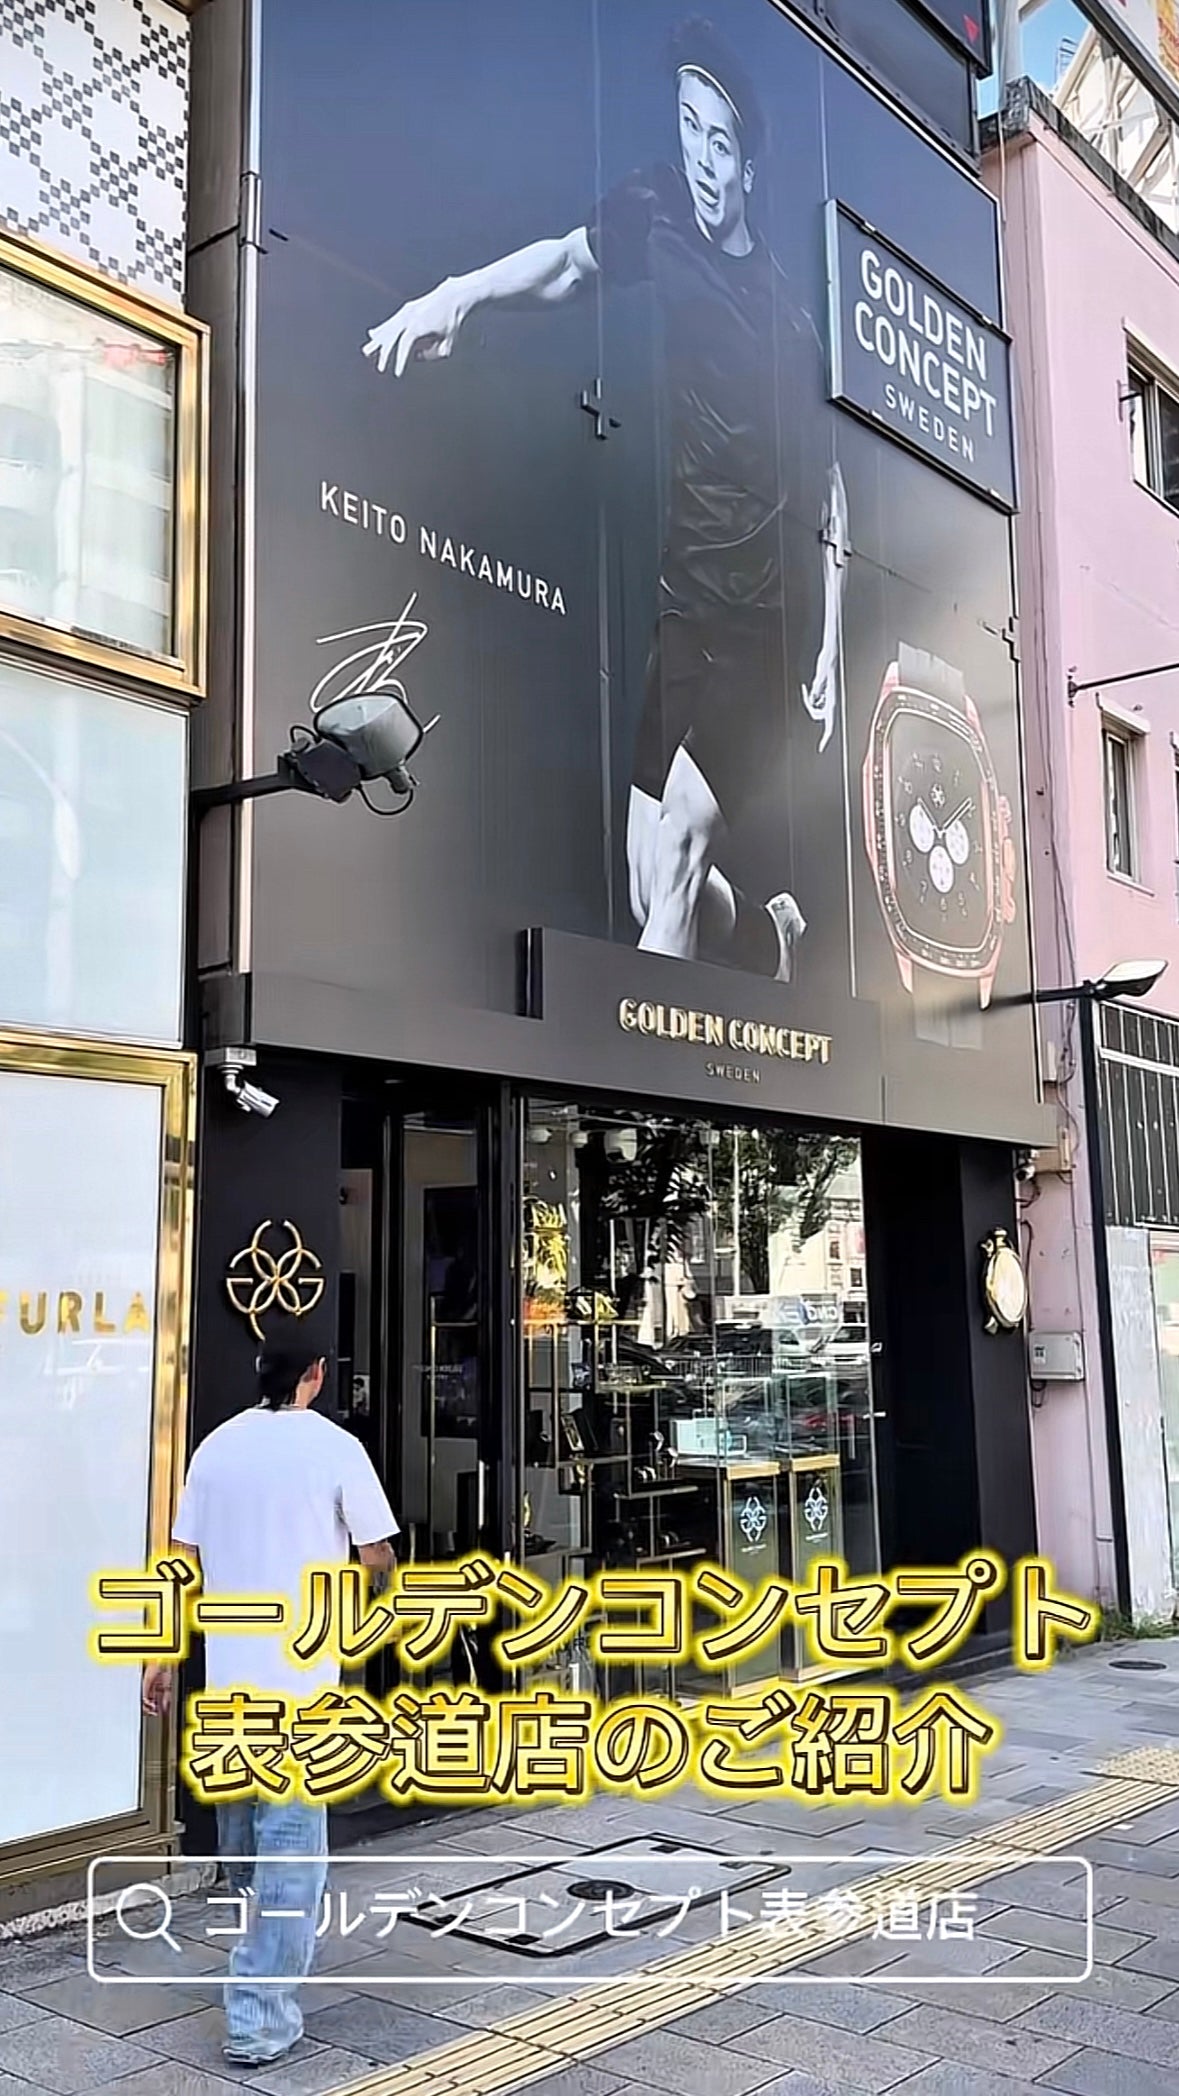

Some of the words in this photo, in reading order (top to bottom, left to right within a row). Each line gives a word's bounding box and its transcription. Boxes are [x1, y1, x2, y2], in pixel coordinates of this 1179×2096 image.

[854, 300, 997, 437] CONCEPT
[860, 249, 987, 382] GOLDEN
[884, 383, 975, 463] SWEDEN
[320, 480, 407, 544] KEITO
[419, 526, 567, 615] NAKAMURA
[618, 998, 725, 1047] GOLDEN
[727, 1018, 833, 1064] CONCEPT
[705, 1062, 761, 1084] SWEDEN
